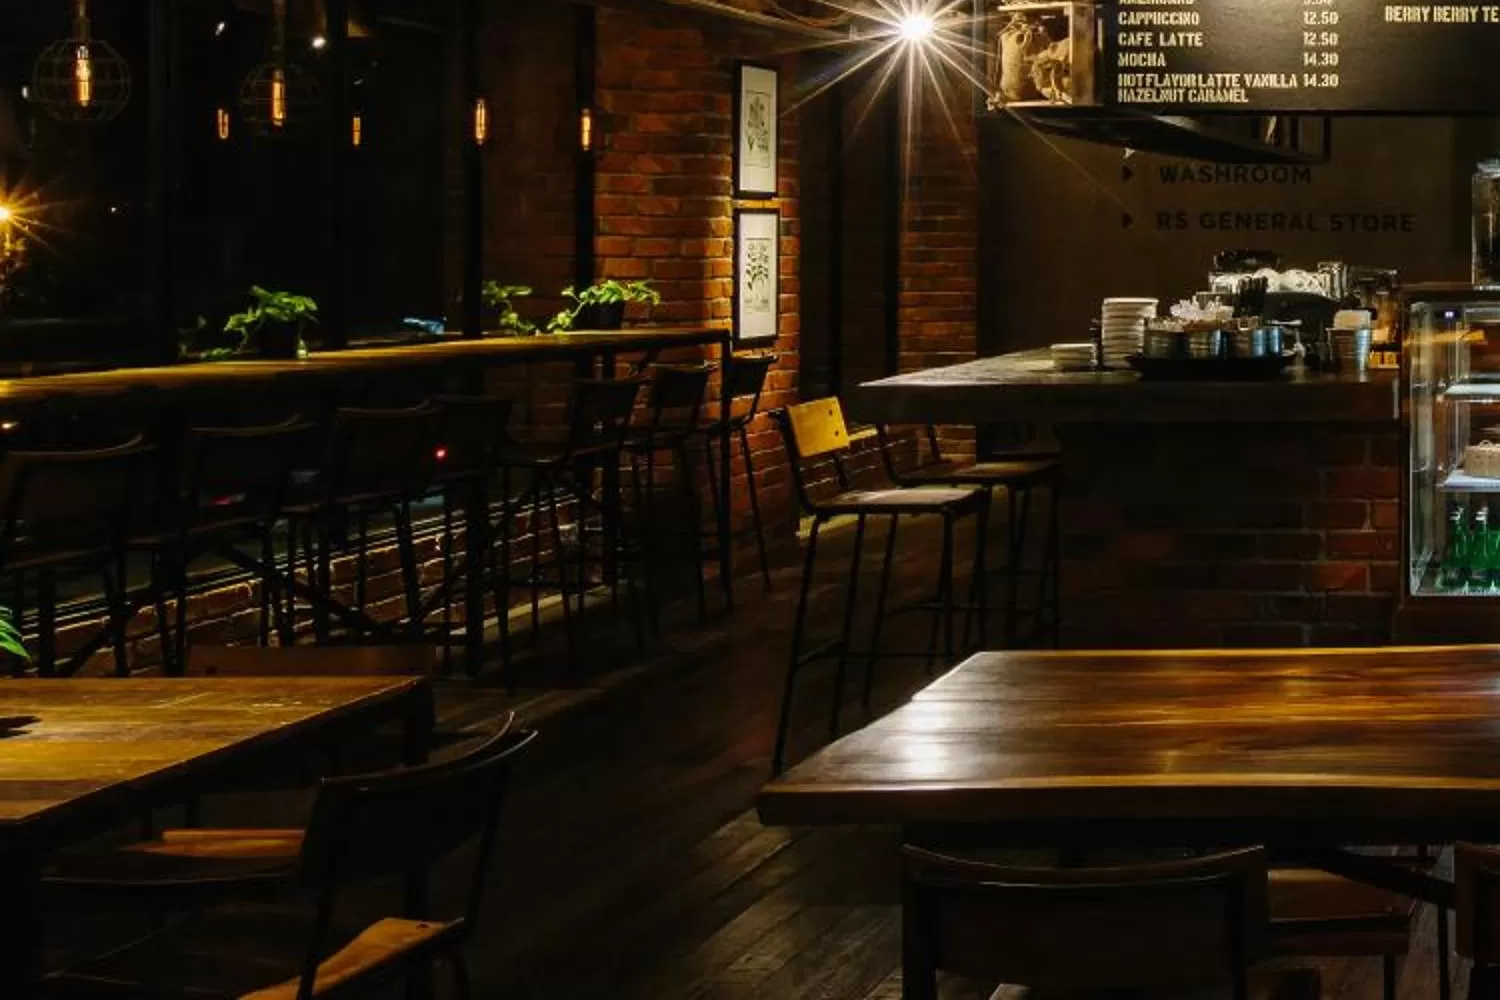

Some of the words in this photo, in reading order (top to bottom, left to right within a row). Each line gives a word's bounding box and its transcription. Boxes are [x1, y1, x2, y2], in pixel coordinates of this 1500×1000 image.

[1118, 11, 1200, 25] CAPPUCCINO
[1303, 11, 1339, 25] 12.50
[1385, 6, 1430, 22] BERRY
[1433, 6, 1478, 22] BERRY
[1118, 32, 1152, 46] CAFE
[1159, 32, 1204, 46] LATTE
[1303, 32, 1339, 46] 12.50
[1118, 52, 1166, 67] MOCHA
[1303, 52, 1339, 67] 14.30
[1118, 74, 1145, 88] HOT
[1146, 74, 1196, 88] FLAVOR
[1198, 74, 1240, 88] LATTE
[1244, 74, 1298, 88] VANILLA
[1303, 74, 1339, 88] 14.30
[1118, 88, 1185, 103] HAZELNUT
[1188, 88, 1248, 103] CARAMEL
[1159, 165, 1311, 184] WASHROOM
[1156, 212, 1188, 231] RS
[1199, 212, 1318, 231] GENERAL
[1329, 213, 1416, 233] STORE
